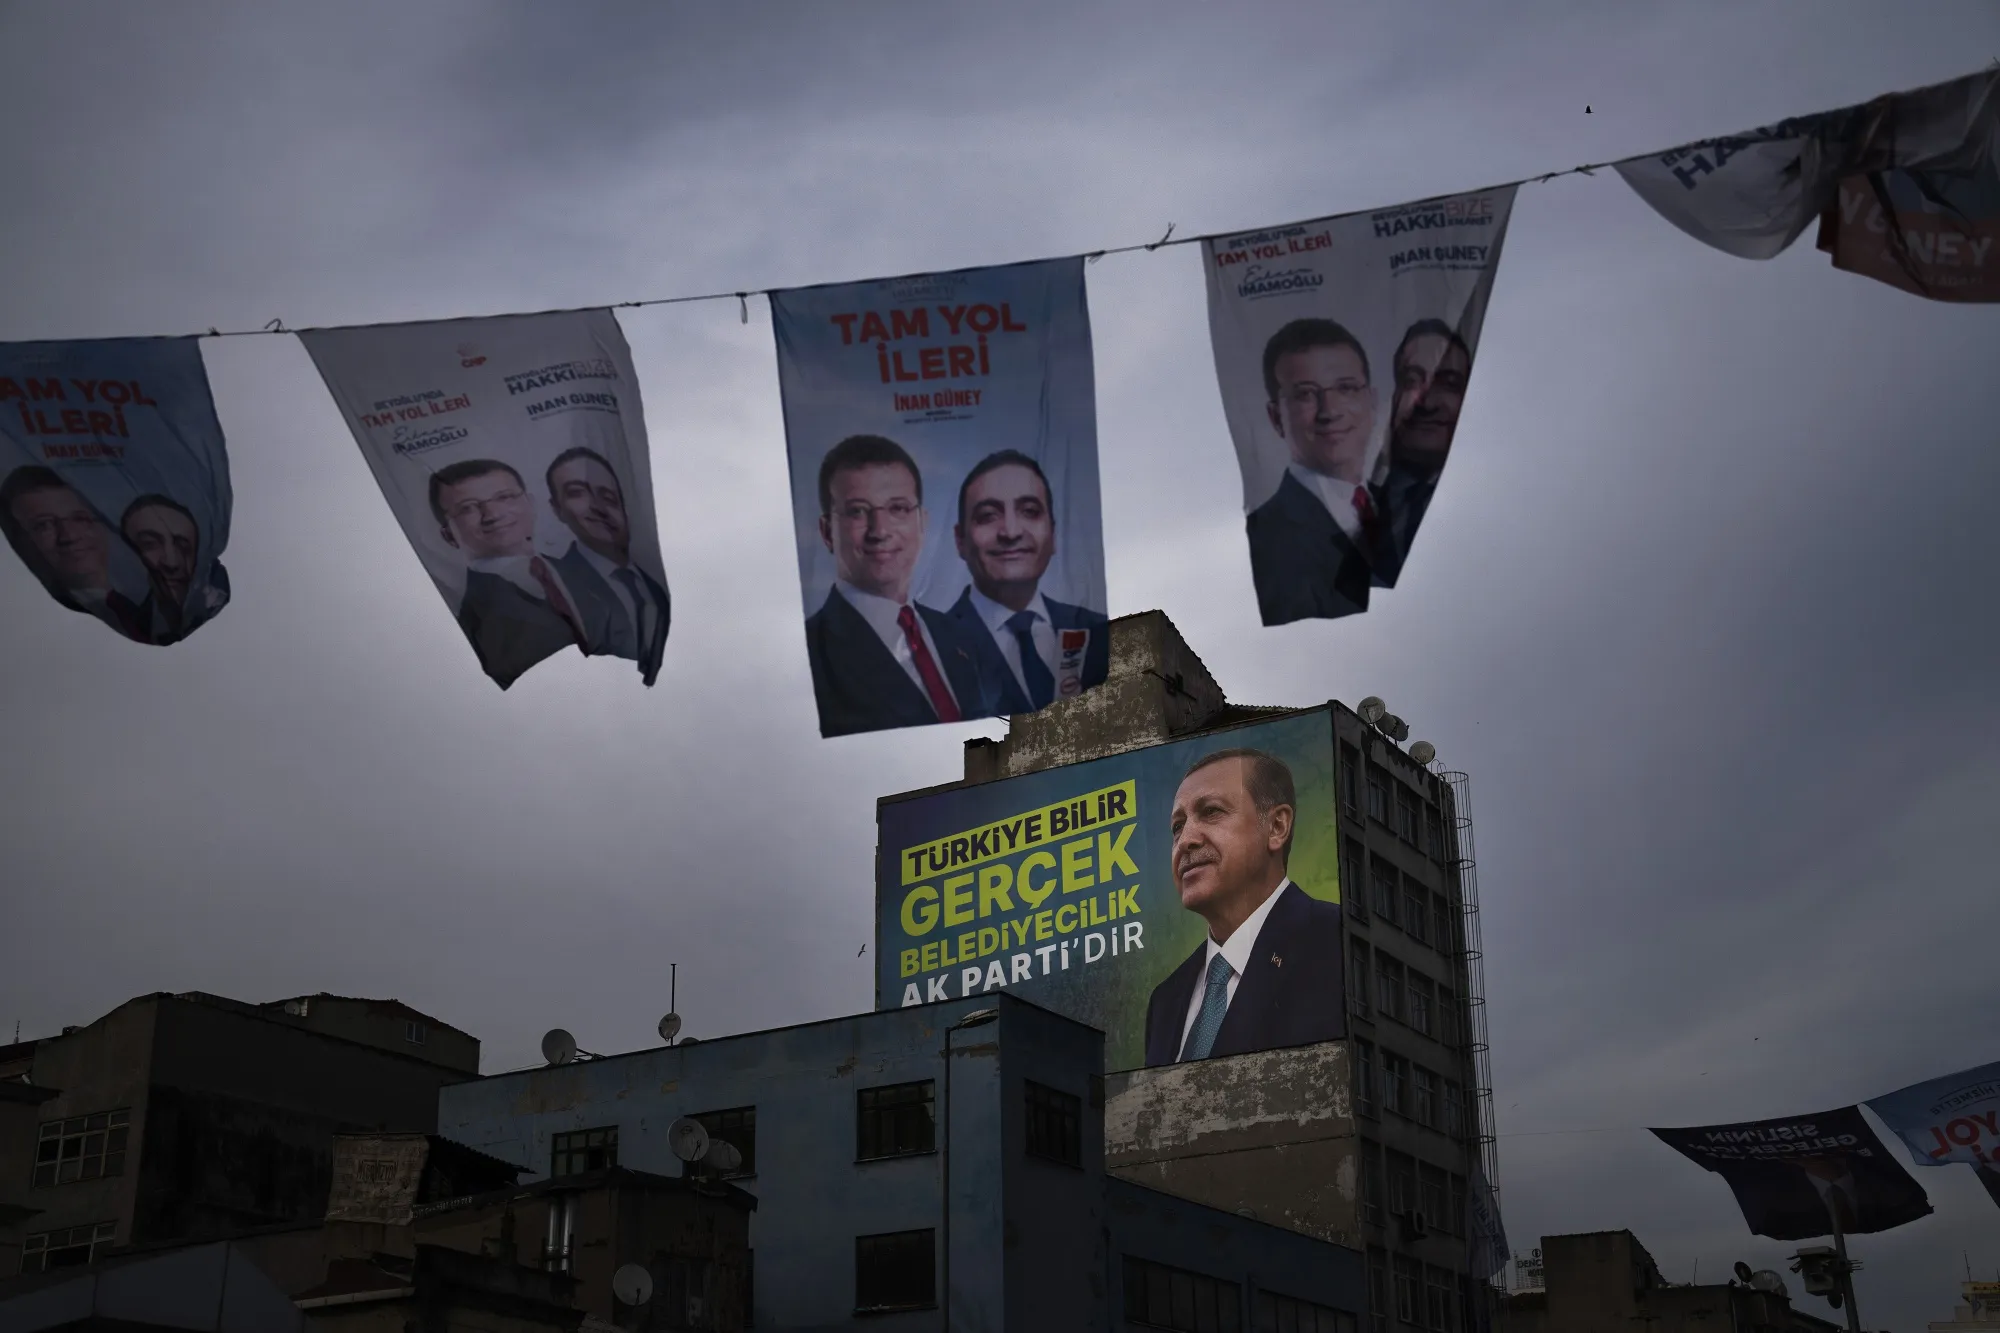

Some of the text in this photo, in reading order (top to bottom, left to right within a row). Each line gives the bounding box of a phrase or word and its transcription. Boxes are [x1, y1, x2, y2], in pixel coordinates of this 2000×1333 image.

[1374, 212, 1446, 237] HAKKI
[1216, 230, 1333, 268] TAM YOL İLERİ
[830, 303, 1027, 346] TAM YOL
[877, 334, 990, 384] İLERİ
[0, 377, 158, 407] AM YOL
[507, 369, 576, 395] HAKKI
[894, 388, 982, 411] İNAN GÜNEY
[17, 396, 130, 438] İLERİ
[361, 393, 472, 428] TAM YOL İLERİ
[908, 787, 1128, 877] TÜRKİYE BİLİR
[900, 822, 1140, 938] GERÇEK
[900, 884, 1142, 979] BELEDİYECİLİK
[901, 973, 950, 1008] AK
